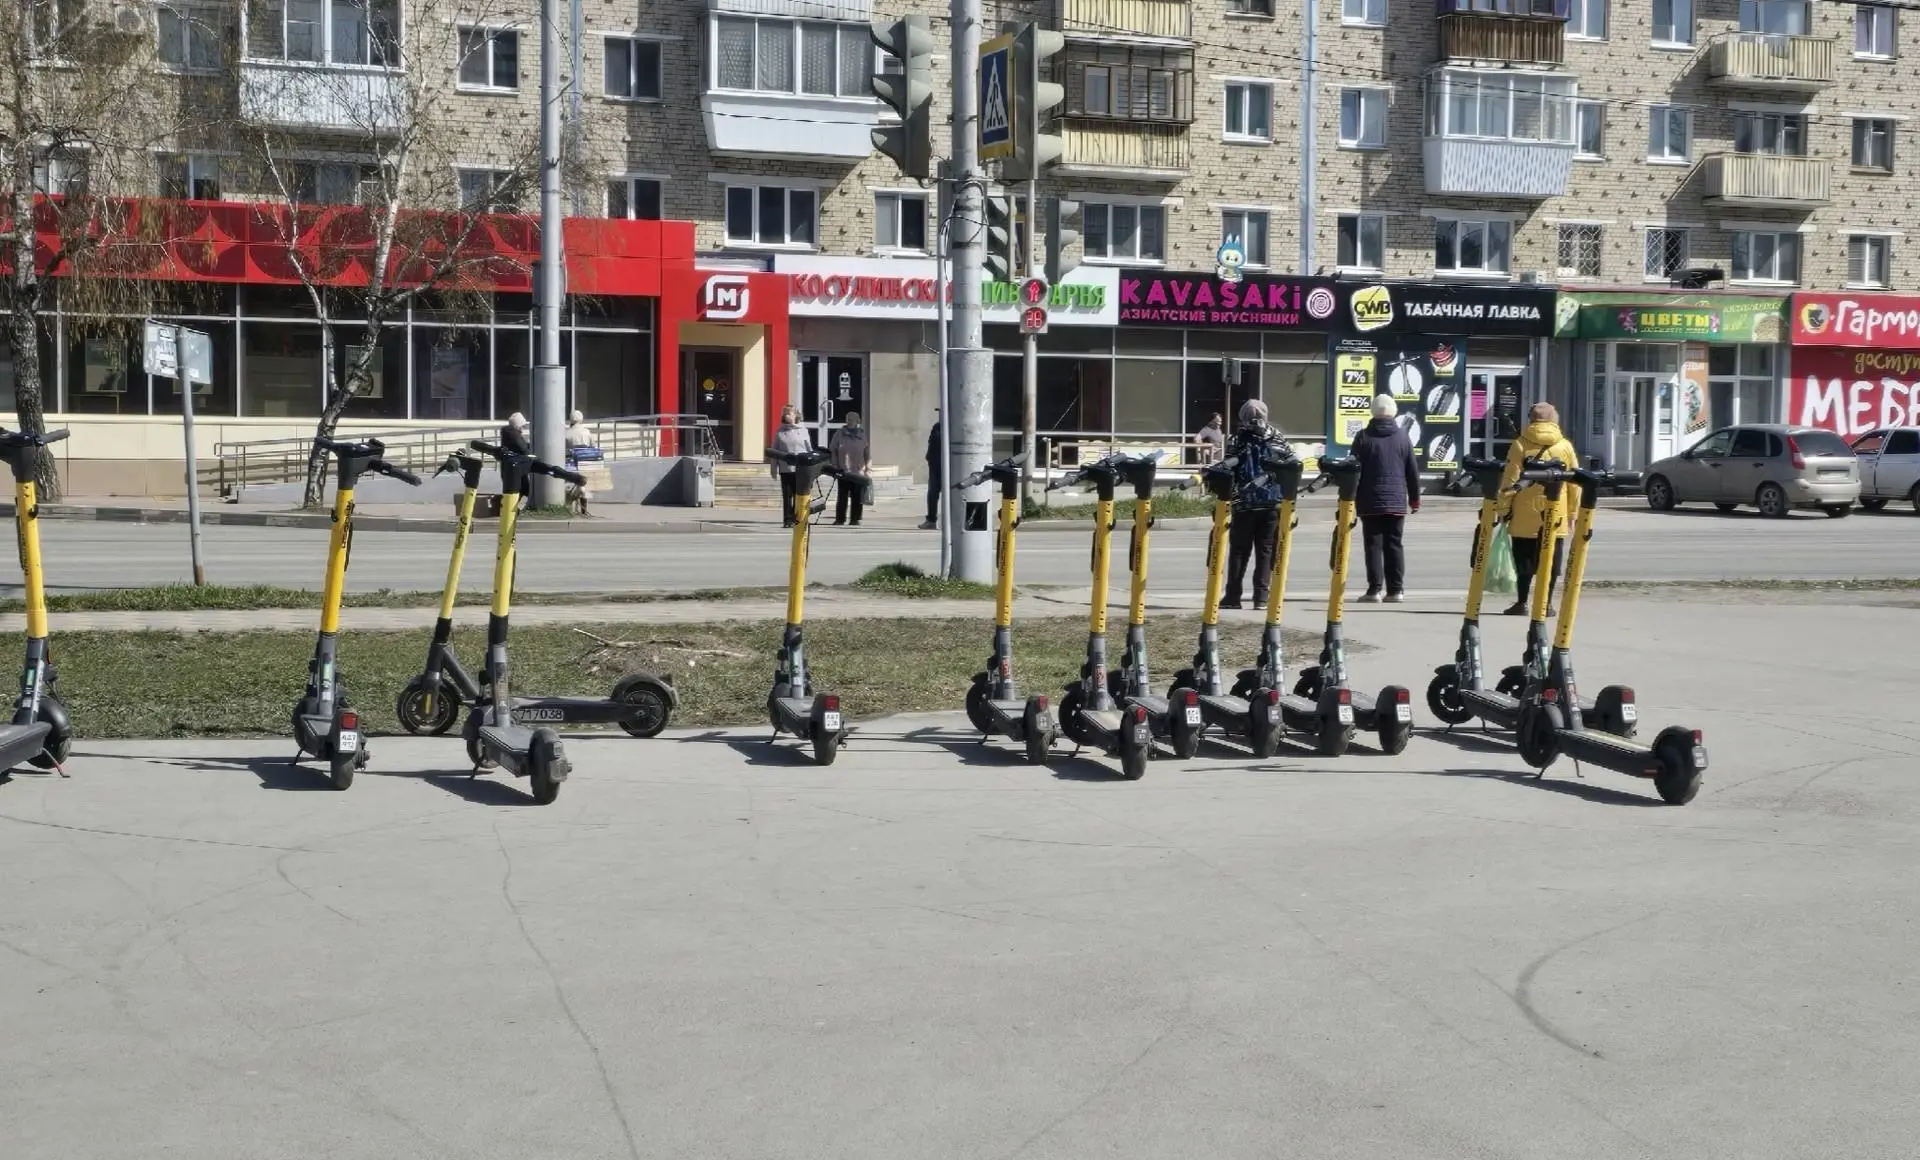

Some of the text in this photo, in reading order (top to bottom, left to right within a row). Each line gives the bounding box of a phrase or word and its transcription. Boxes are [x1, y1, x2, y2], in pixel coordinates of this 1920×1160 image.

[982, 280, 1107, 308] ИВАРНЯ
[1120, 309, 1300, 325] АЗИАТСКИЕ ВКУСНЯШКИ
[1404, 302, 1541, 319] ТАБАЧНАЯ ЛАВКА
[1640, 312, 1710, 328] ЦВЕТЫ
[1834, 300, 1920, 341] Гармо
[1344, 371, 1366, 383] 7%
[1340, 396, 1370, 408] 50%
